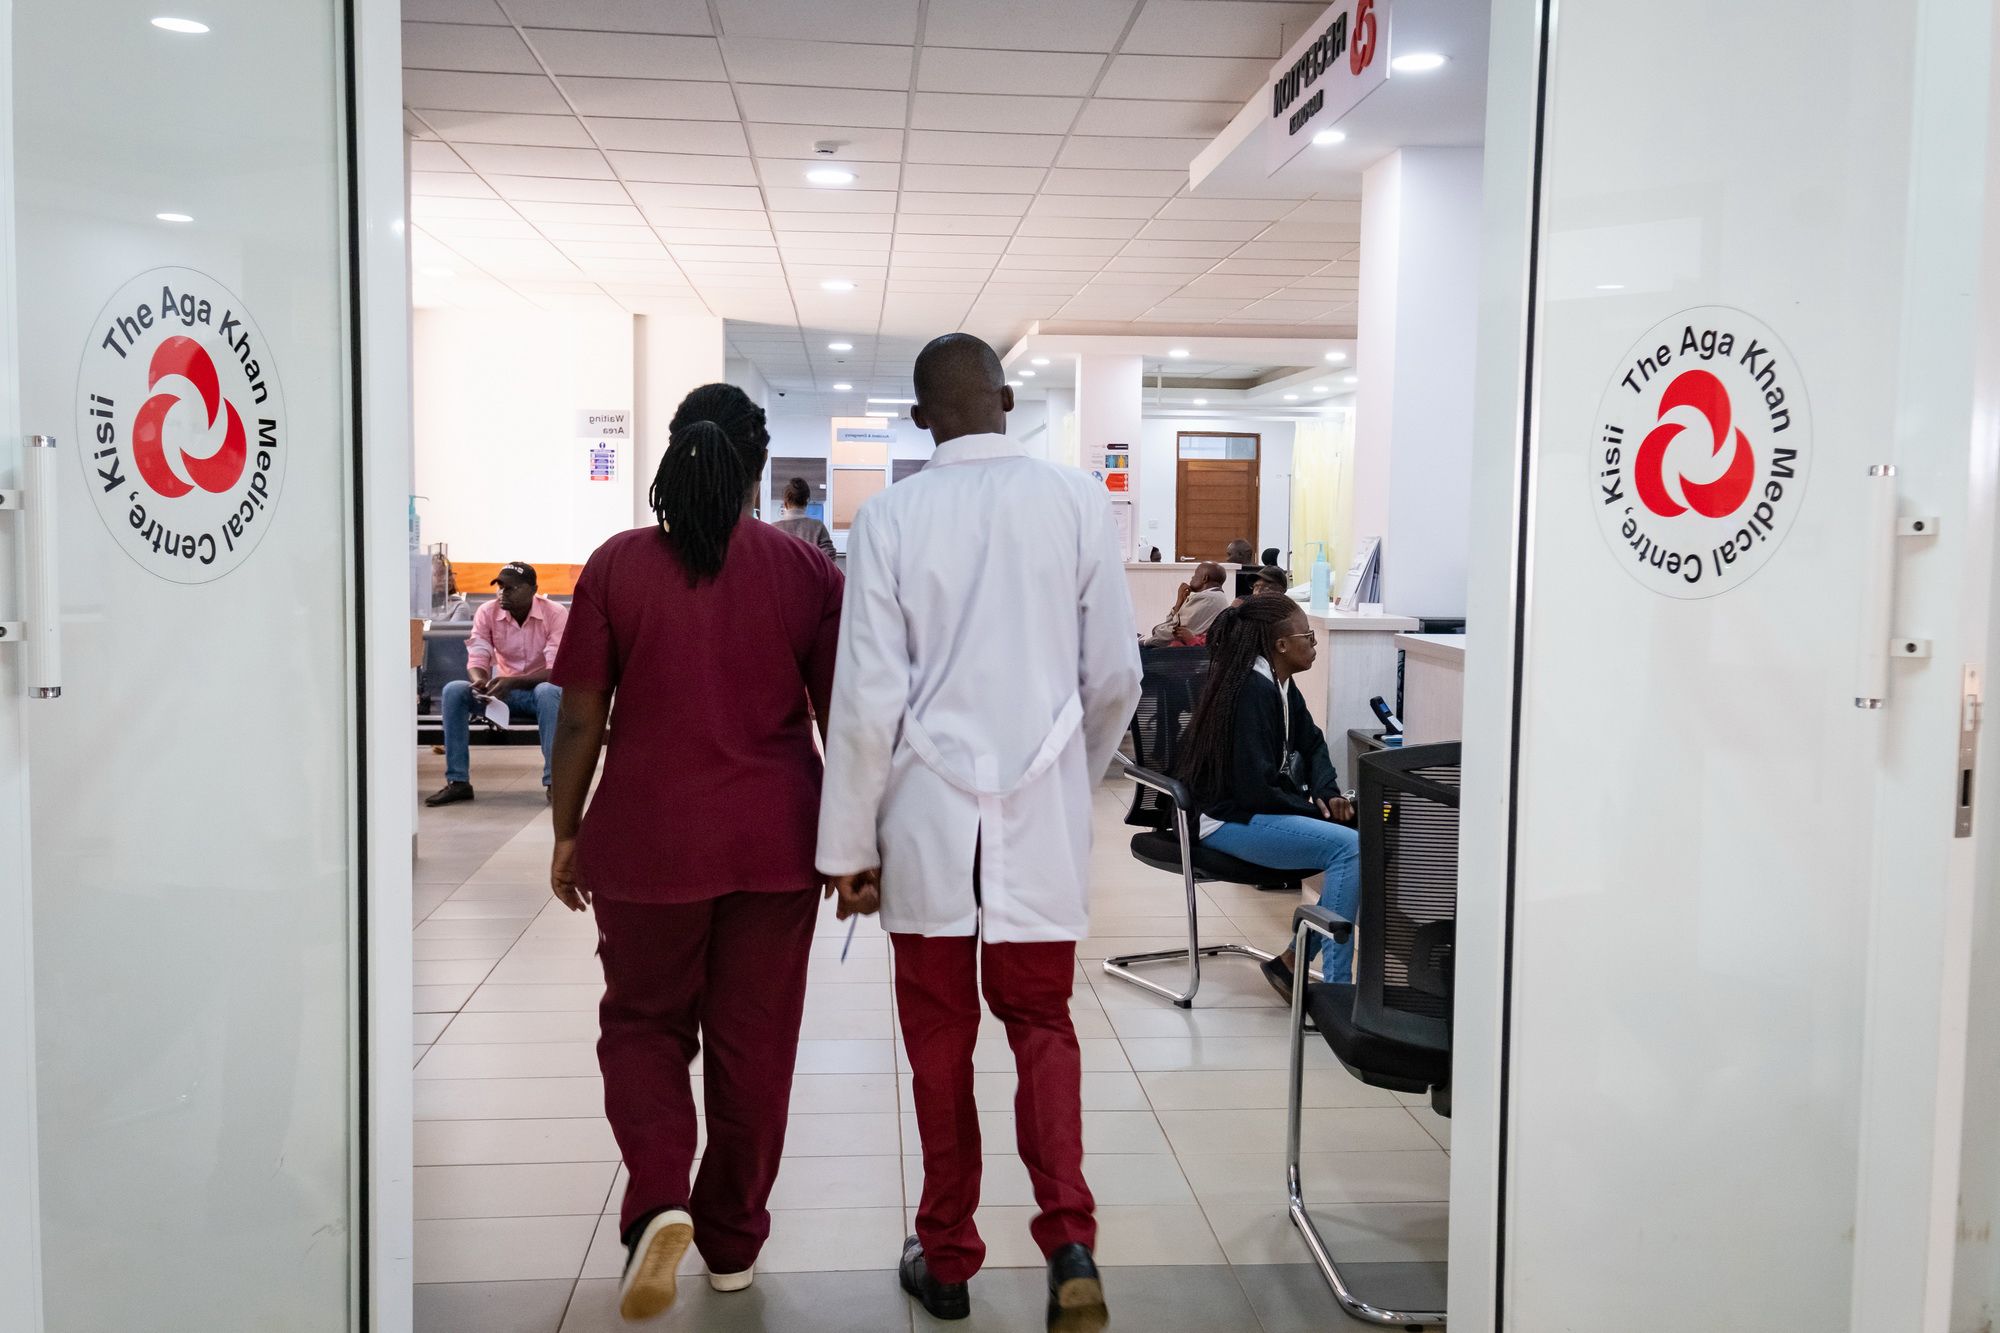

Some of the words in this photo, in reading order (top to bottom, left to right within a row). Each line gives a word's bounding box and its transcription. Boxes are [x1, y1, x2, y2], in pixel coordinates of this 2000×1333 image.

[102, 303, 154, 359] The
[161, 285, 212, 326] Aga
[1679, 325, 1736, 361] Aga
[218, 309, 269, 405] Khan
[1621, 344, 1672, 394] The
[1740, 339, 1791, 434] Khan
[89, 393, 126, 493] Kisii
[1600, 424, 1625, 505] Kisii
[222, 418, 278, 552] Medical
[1712, 447, 1798, 577] Medical
[129, 491, 217, 565] Centre,
[1621, 506, 1702, 583] Centre,
